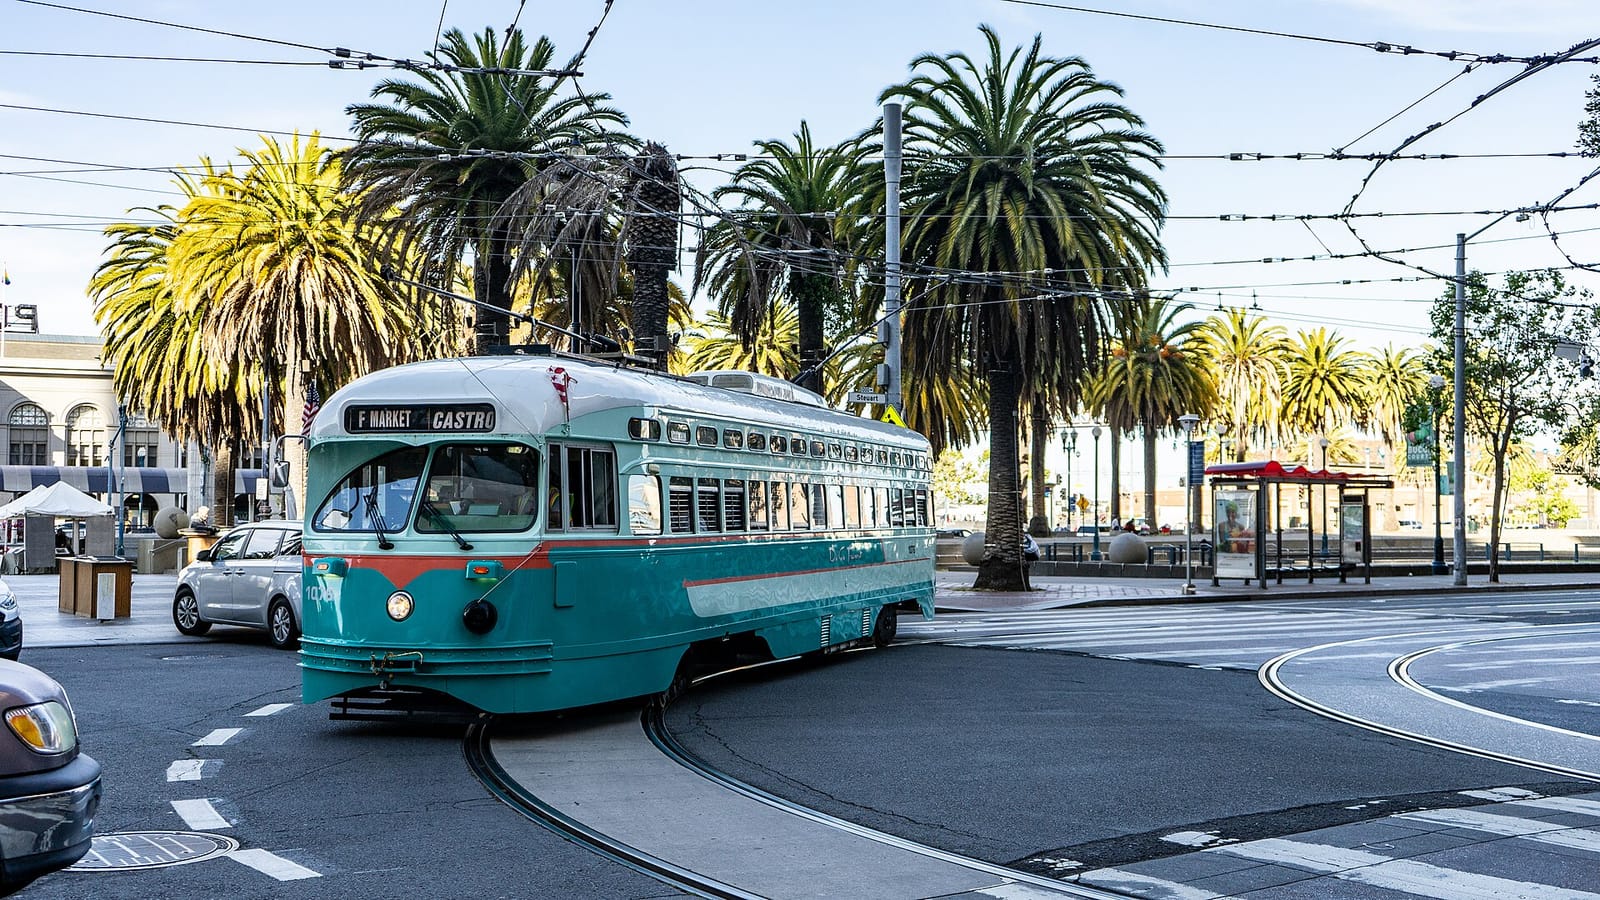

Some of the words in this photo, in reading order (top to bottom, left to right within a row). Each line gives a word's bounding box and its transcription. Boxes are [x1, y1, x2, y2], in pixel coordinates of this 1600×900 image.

[358, 411, 366, 428] F
[370, 410, 411, 428] MARKET
[433, 411, 494, 429] CASTRO
